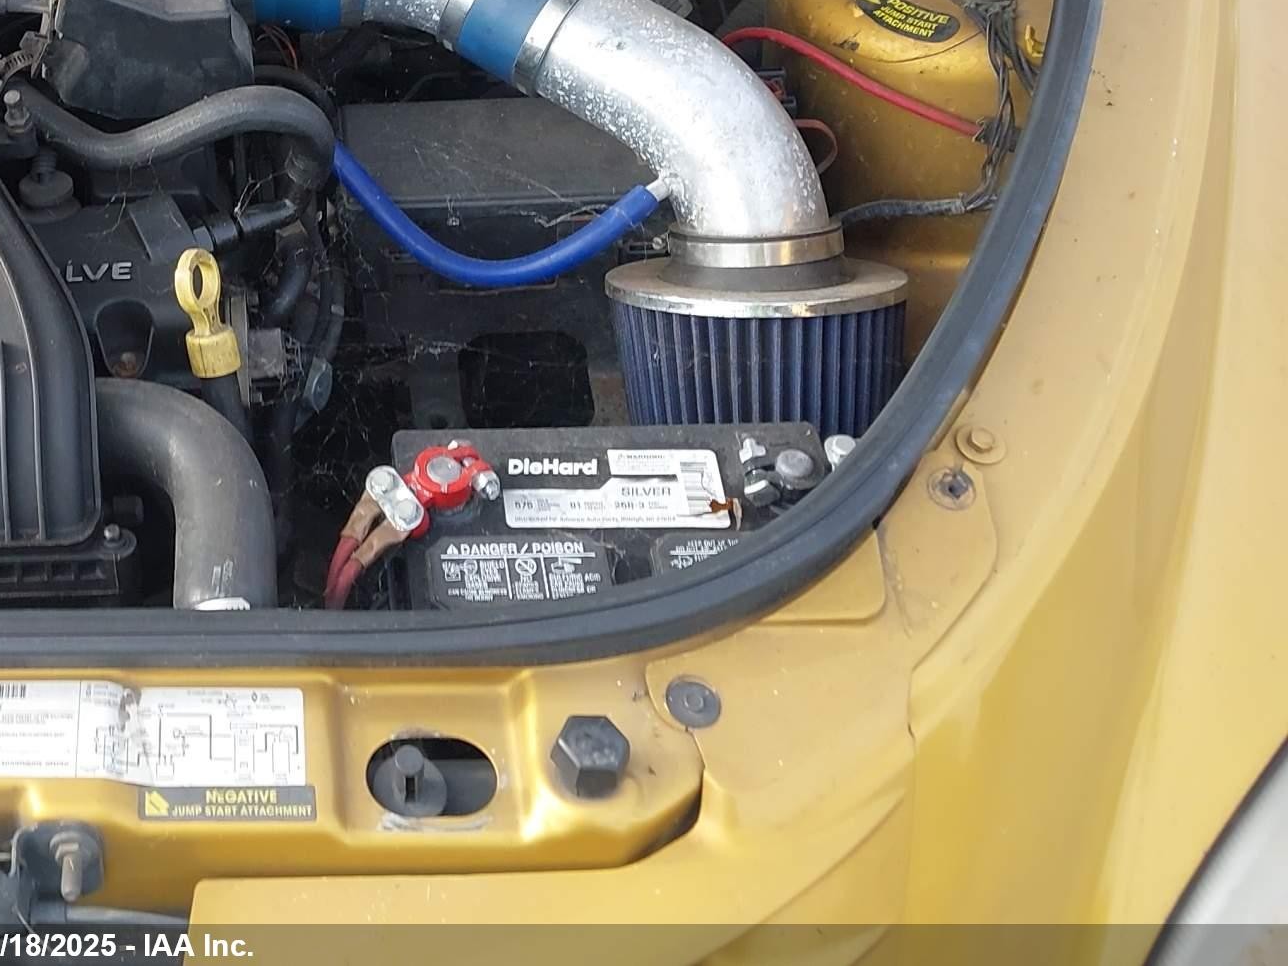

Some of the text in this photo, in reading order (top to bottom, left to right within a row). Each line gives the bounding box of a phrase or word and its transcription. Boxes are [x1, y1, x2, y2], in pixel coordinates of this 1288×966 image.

[872, 8, 936, 38] ATTACHMENT
[880, 5, 939, 30] JUMP START
[508, 458, 599, 476] DieHard
[621, 487, 671, 497] SILVER
[461, 543, 518, 556] DANGER
[532, 541, 585, 554] POISON
[206, 789, 278, 804] NEGATIVE
[171, 804, 312, 816] JUMP START ATTACHMENT
